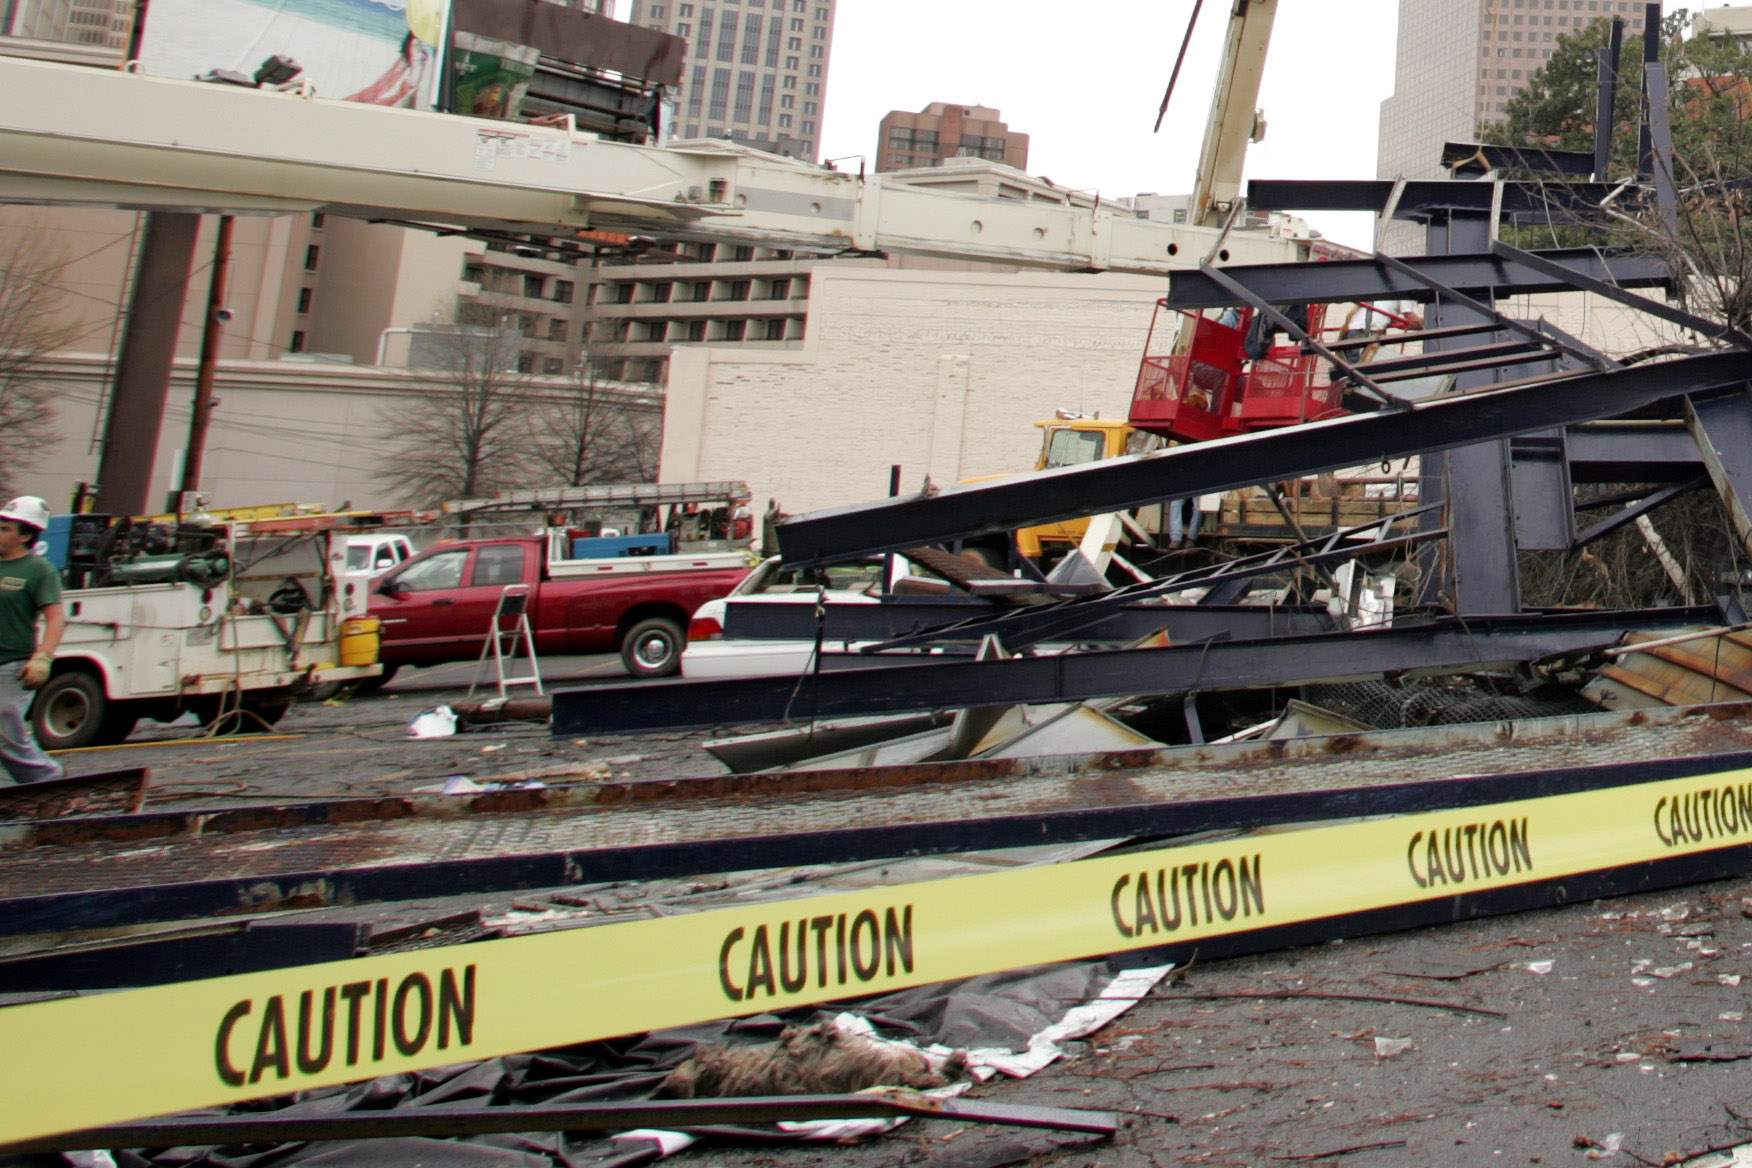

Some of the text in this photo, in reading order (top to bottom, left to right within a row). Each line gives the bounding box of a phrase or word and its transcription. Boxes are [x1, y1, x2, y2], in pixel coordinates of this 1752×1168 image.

[215, 964, 476, 1087] CAUTION
[718, 904, 914, 1002] CAUTION
[1111, 854, 1265, 938] CAUTION
[1408, 817, 1533, 888] CAUTION
